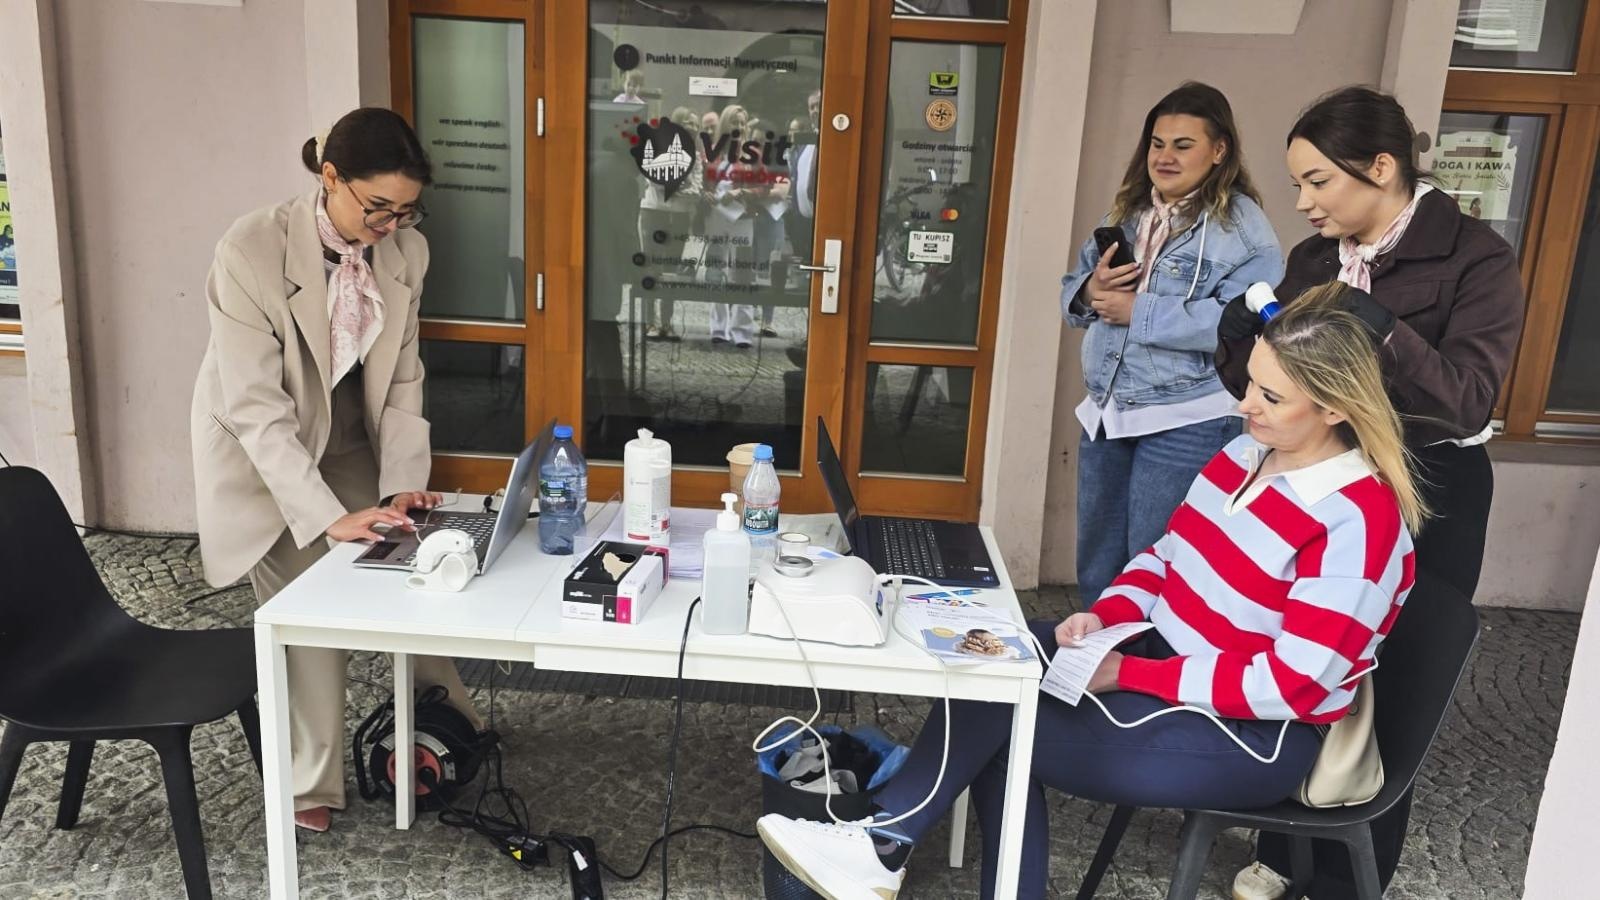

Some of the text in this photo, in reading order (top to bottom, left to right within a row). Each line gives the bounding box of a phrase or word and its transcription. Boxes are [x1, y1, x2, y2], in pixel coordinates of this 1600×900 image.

[645, 52, 798, 72] Punkt Informacji Turystycznej
[700, 129, 792, 166] Visit
[902, 140, 936, 152] Godziny
[1474, 162, 1512, 170] KAWA
[0, 201, 11, 212] N
[925, 234, 950, 242] KUPISZ
